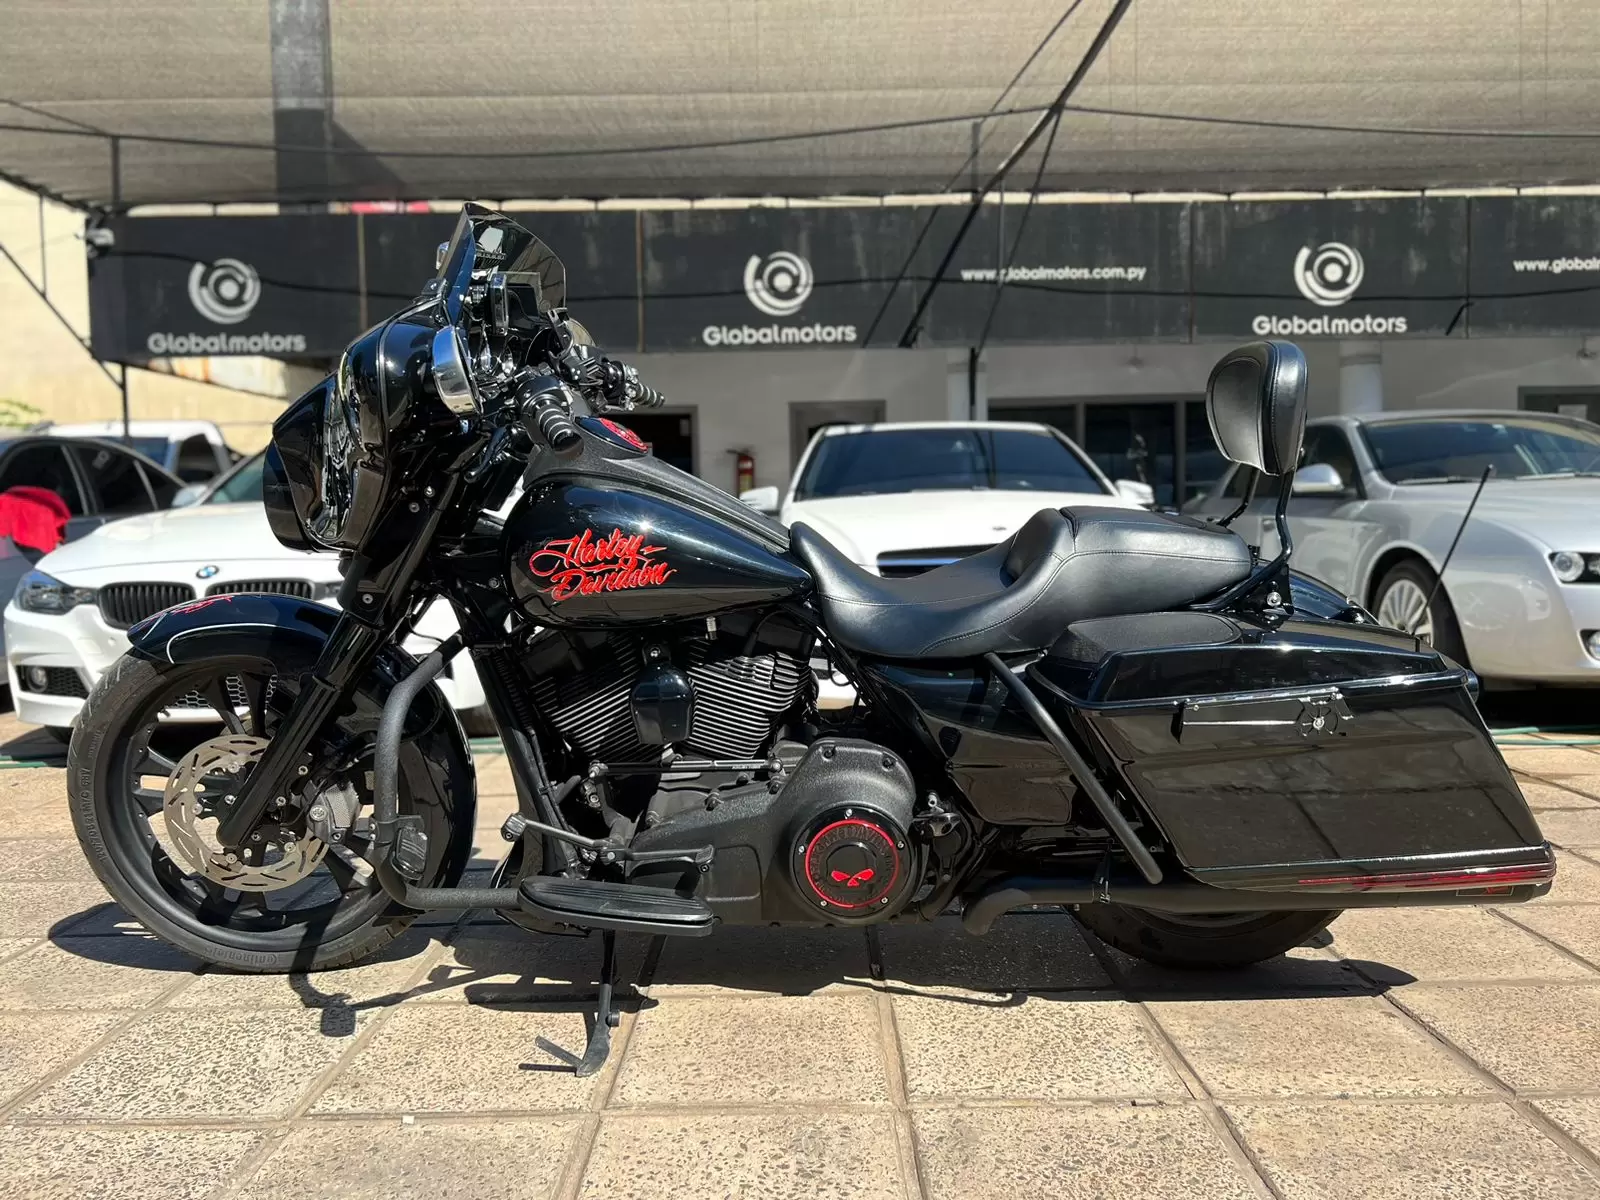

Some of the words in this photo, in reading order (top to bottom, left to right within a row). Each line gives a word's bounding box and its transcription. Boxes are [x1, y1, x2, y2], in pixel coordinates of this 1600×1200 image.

[1513, 256, 1600, 274] www.global
[702, 323, 857, 346] Globalmotors
[1252, 314, 1408, 335] Globalmotors
[148, 332, 307, 353] Globalmotors
[537, 560, 677, 601] Davidson
